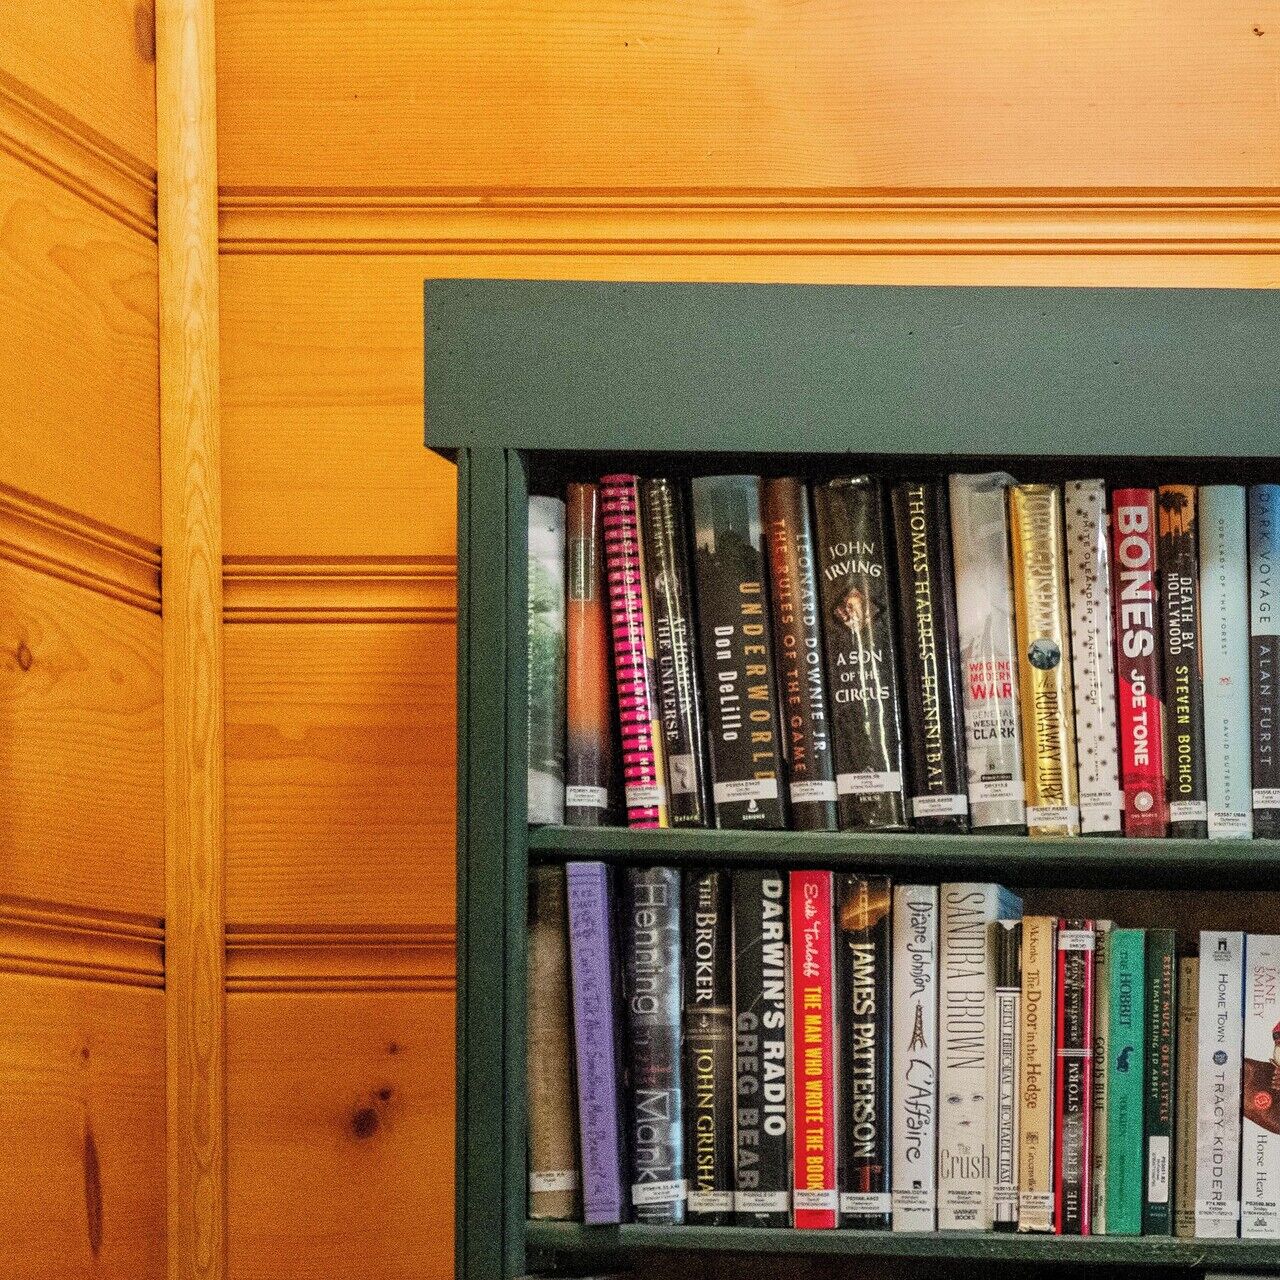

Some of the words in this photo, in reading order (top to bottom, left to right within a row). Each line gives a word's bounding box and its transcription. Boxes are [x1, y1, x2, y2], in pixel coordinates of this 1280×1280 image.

[906, 487, 926, 573] THOMAS
[1258, 493, 1272, 541] DARK
[825, 559, 882, 581] IRVING
[829, 541, 876, 557] JOHN
[1117, 505, 1155, 658] BONES
[1179, 576, 1194, 621] DEATH
[1258, 550, 1272, 623] VOYAGE
[714, 626, 735, 660] Don
[915, 579, 937, 669] HARRIS
[1167, 573, 1181, 655] HOLLYWOOD
[1182, 627, 1193, 650] BY
[739, 582, 777, 779] UNDERWORLD
[835, 686, 890, 703] CIRCUS
[1130, 669, 1148, 707] JOE
[1175, 666, 1189, 725] STEVEN
[1260, 645, 1271, 695] ALAN
[717, 670, 739, 742] DeLillo
[922, 675, 943, 790] HANNIBAL
[973, 727, 1015, 740] CLARK
[1260, 703, 1272, 765] FURST
[1132, 708, 1149, 766] TONE
[1178, 735, 1192, 793] BOCHCO
[631, 884, 664, 1016] Henning
[695, 912, 717, 1002] BROKER
[761, 878, 786, 1029] DARWIN'S
[947, 892, 985, 979] SANDRA
[802, 986, 821, 1017] THE
[849, 942, 875, 1016] JAMES
[737, 1011, 759, 1094] GREG
[803, 1021, 821, 1044] MAN
[947, 990, 985, 1070] BROWN
[697, 1040, 715, 1104] JOHN
[763, 1043, 786, 1135] RADIO
[804, 1048, 822, 1075] WHO
[851, 1022, 876, 1158] PATTERSON
[1067, 1062, 1079, 1111] STORM
[804, 1080, 822, 1123] WROTE
[1213, 1072, 1224, 1130] TRACY
[805, 1125, 823, 1149] THE
[941, 1145, 991, 1179] Crush
[1212, 1137, 1223, 1200] KIDDER
